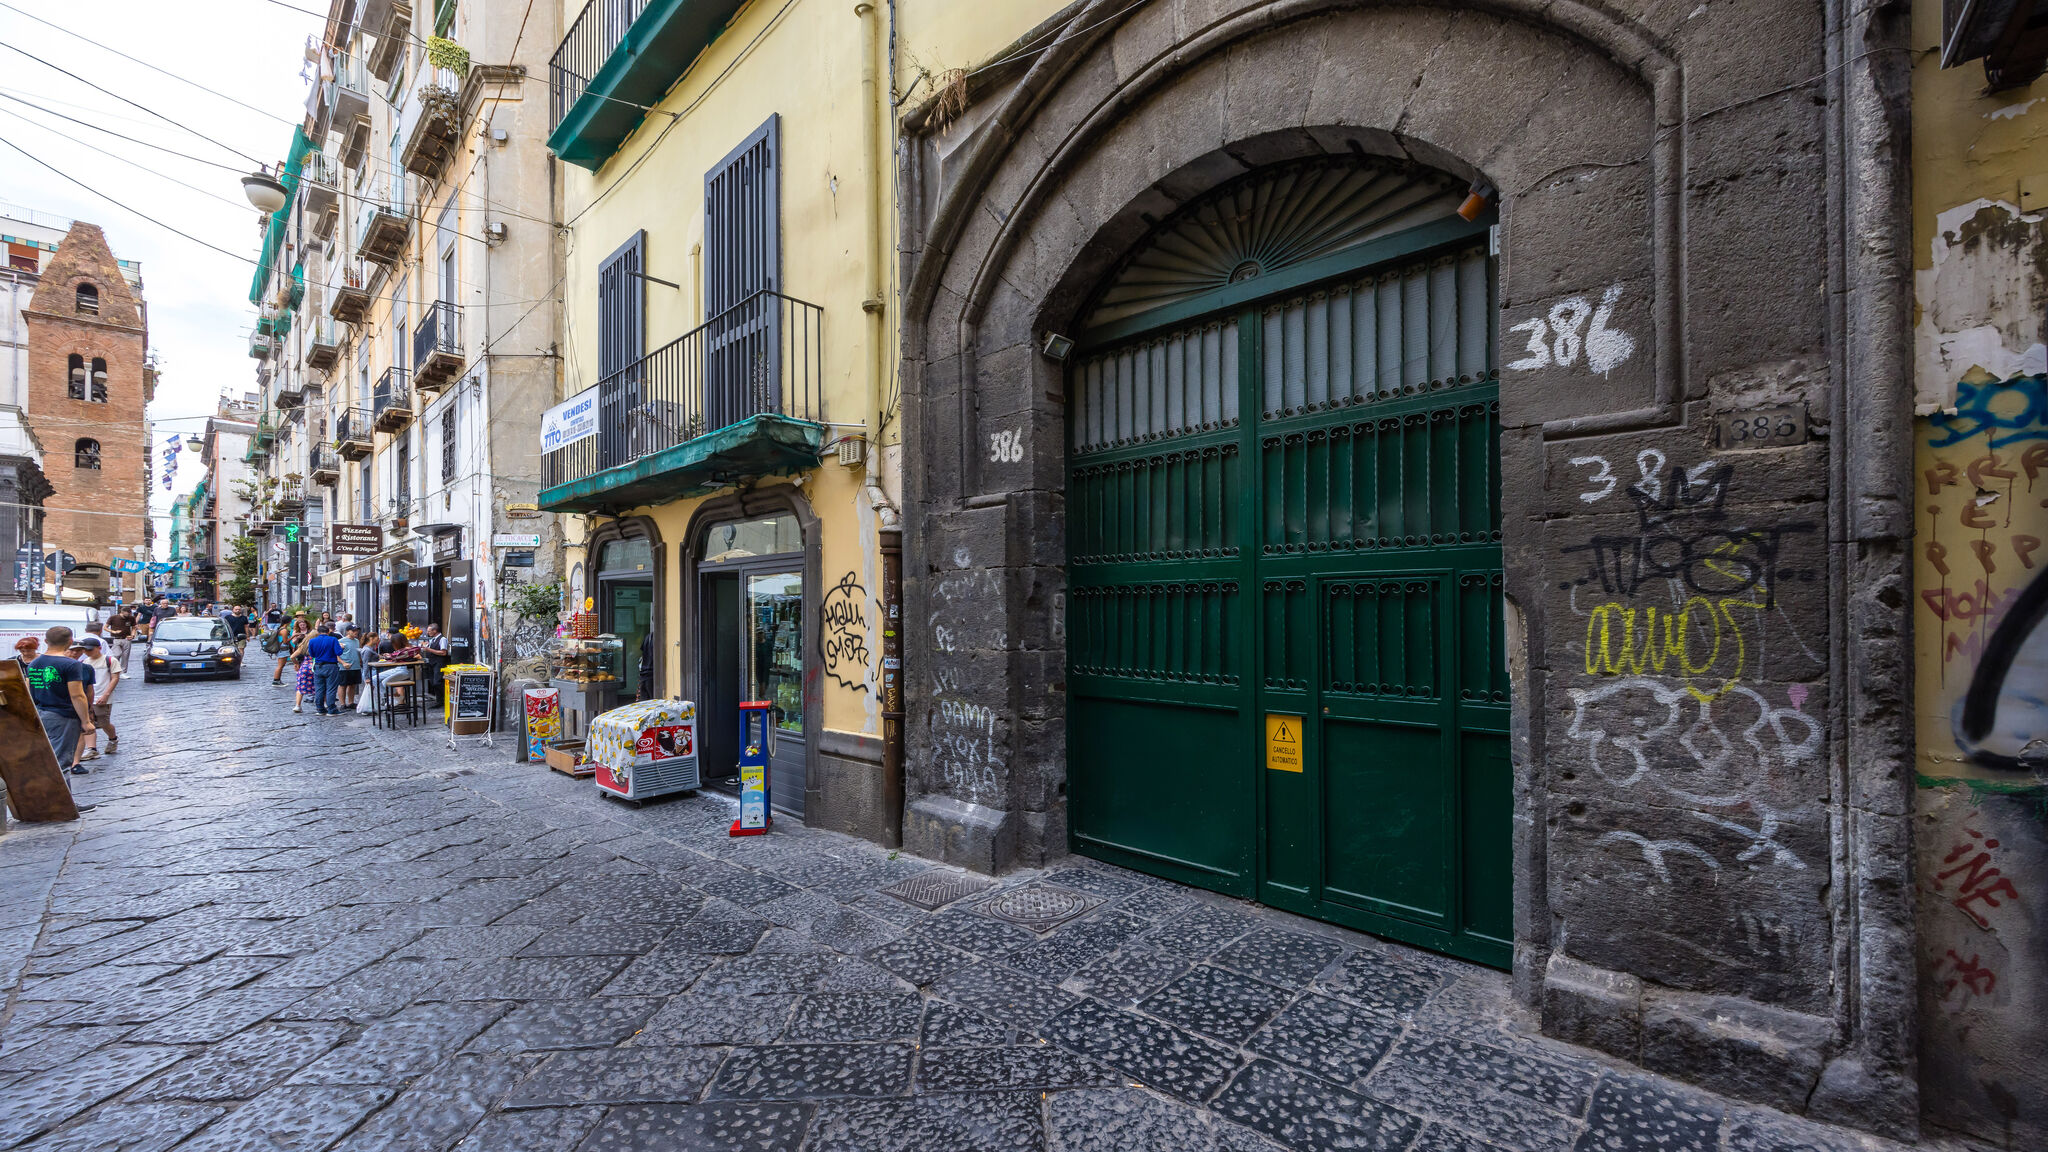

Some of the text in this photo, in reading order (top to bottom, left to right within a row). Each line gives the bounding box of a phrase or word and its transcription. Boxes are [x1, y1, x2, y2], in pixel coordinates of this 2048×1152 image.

[1506, 283, 1635, 378] 386
[562, 399, 592, 420] VENDESI
[544, 430, 561, 448] TITO
[990, 426, 1024, 463] 386
[1273, 746, 1296, 755] CANCELLO
[1271, 756, 1298, 765] AUTOMATICO
